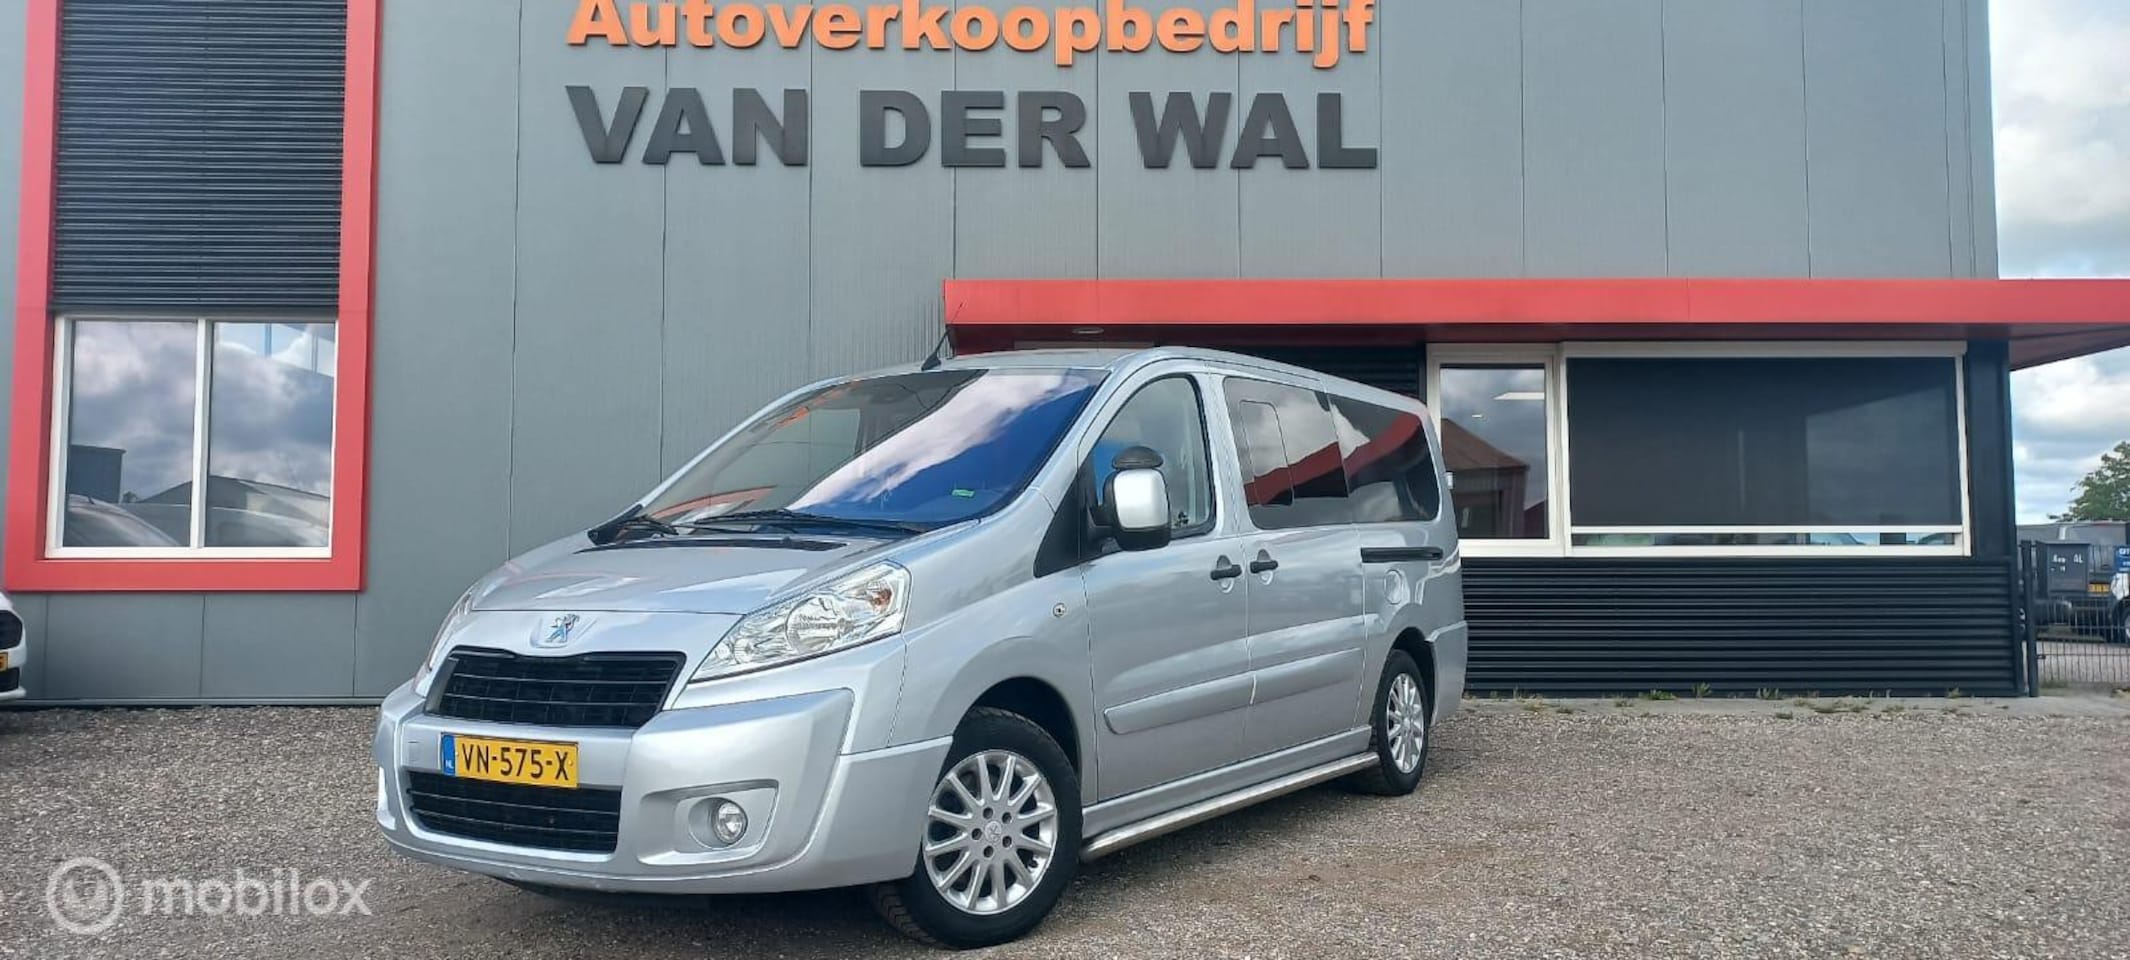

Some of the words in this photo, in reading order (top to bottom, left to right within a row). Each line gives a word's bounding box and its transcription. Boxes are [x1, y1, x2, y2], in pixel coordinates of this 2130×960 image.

[566, 0, 1376, 68] Autoverkoopbedrijf
[565, 85, 808, 166] VAN
[860, 89, 1091, 168] DER
[1129, 91, 1378, 169] WAL
[461, 743, 569, 781] VN-575-X
